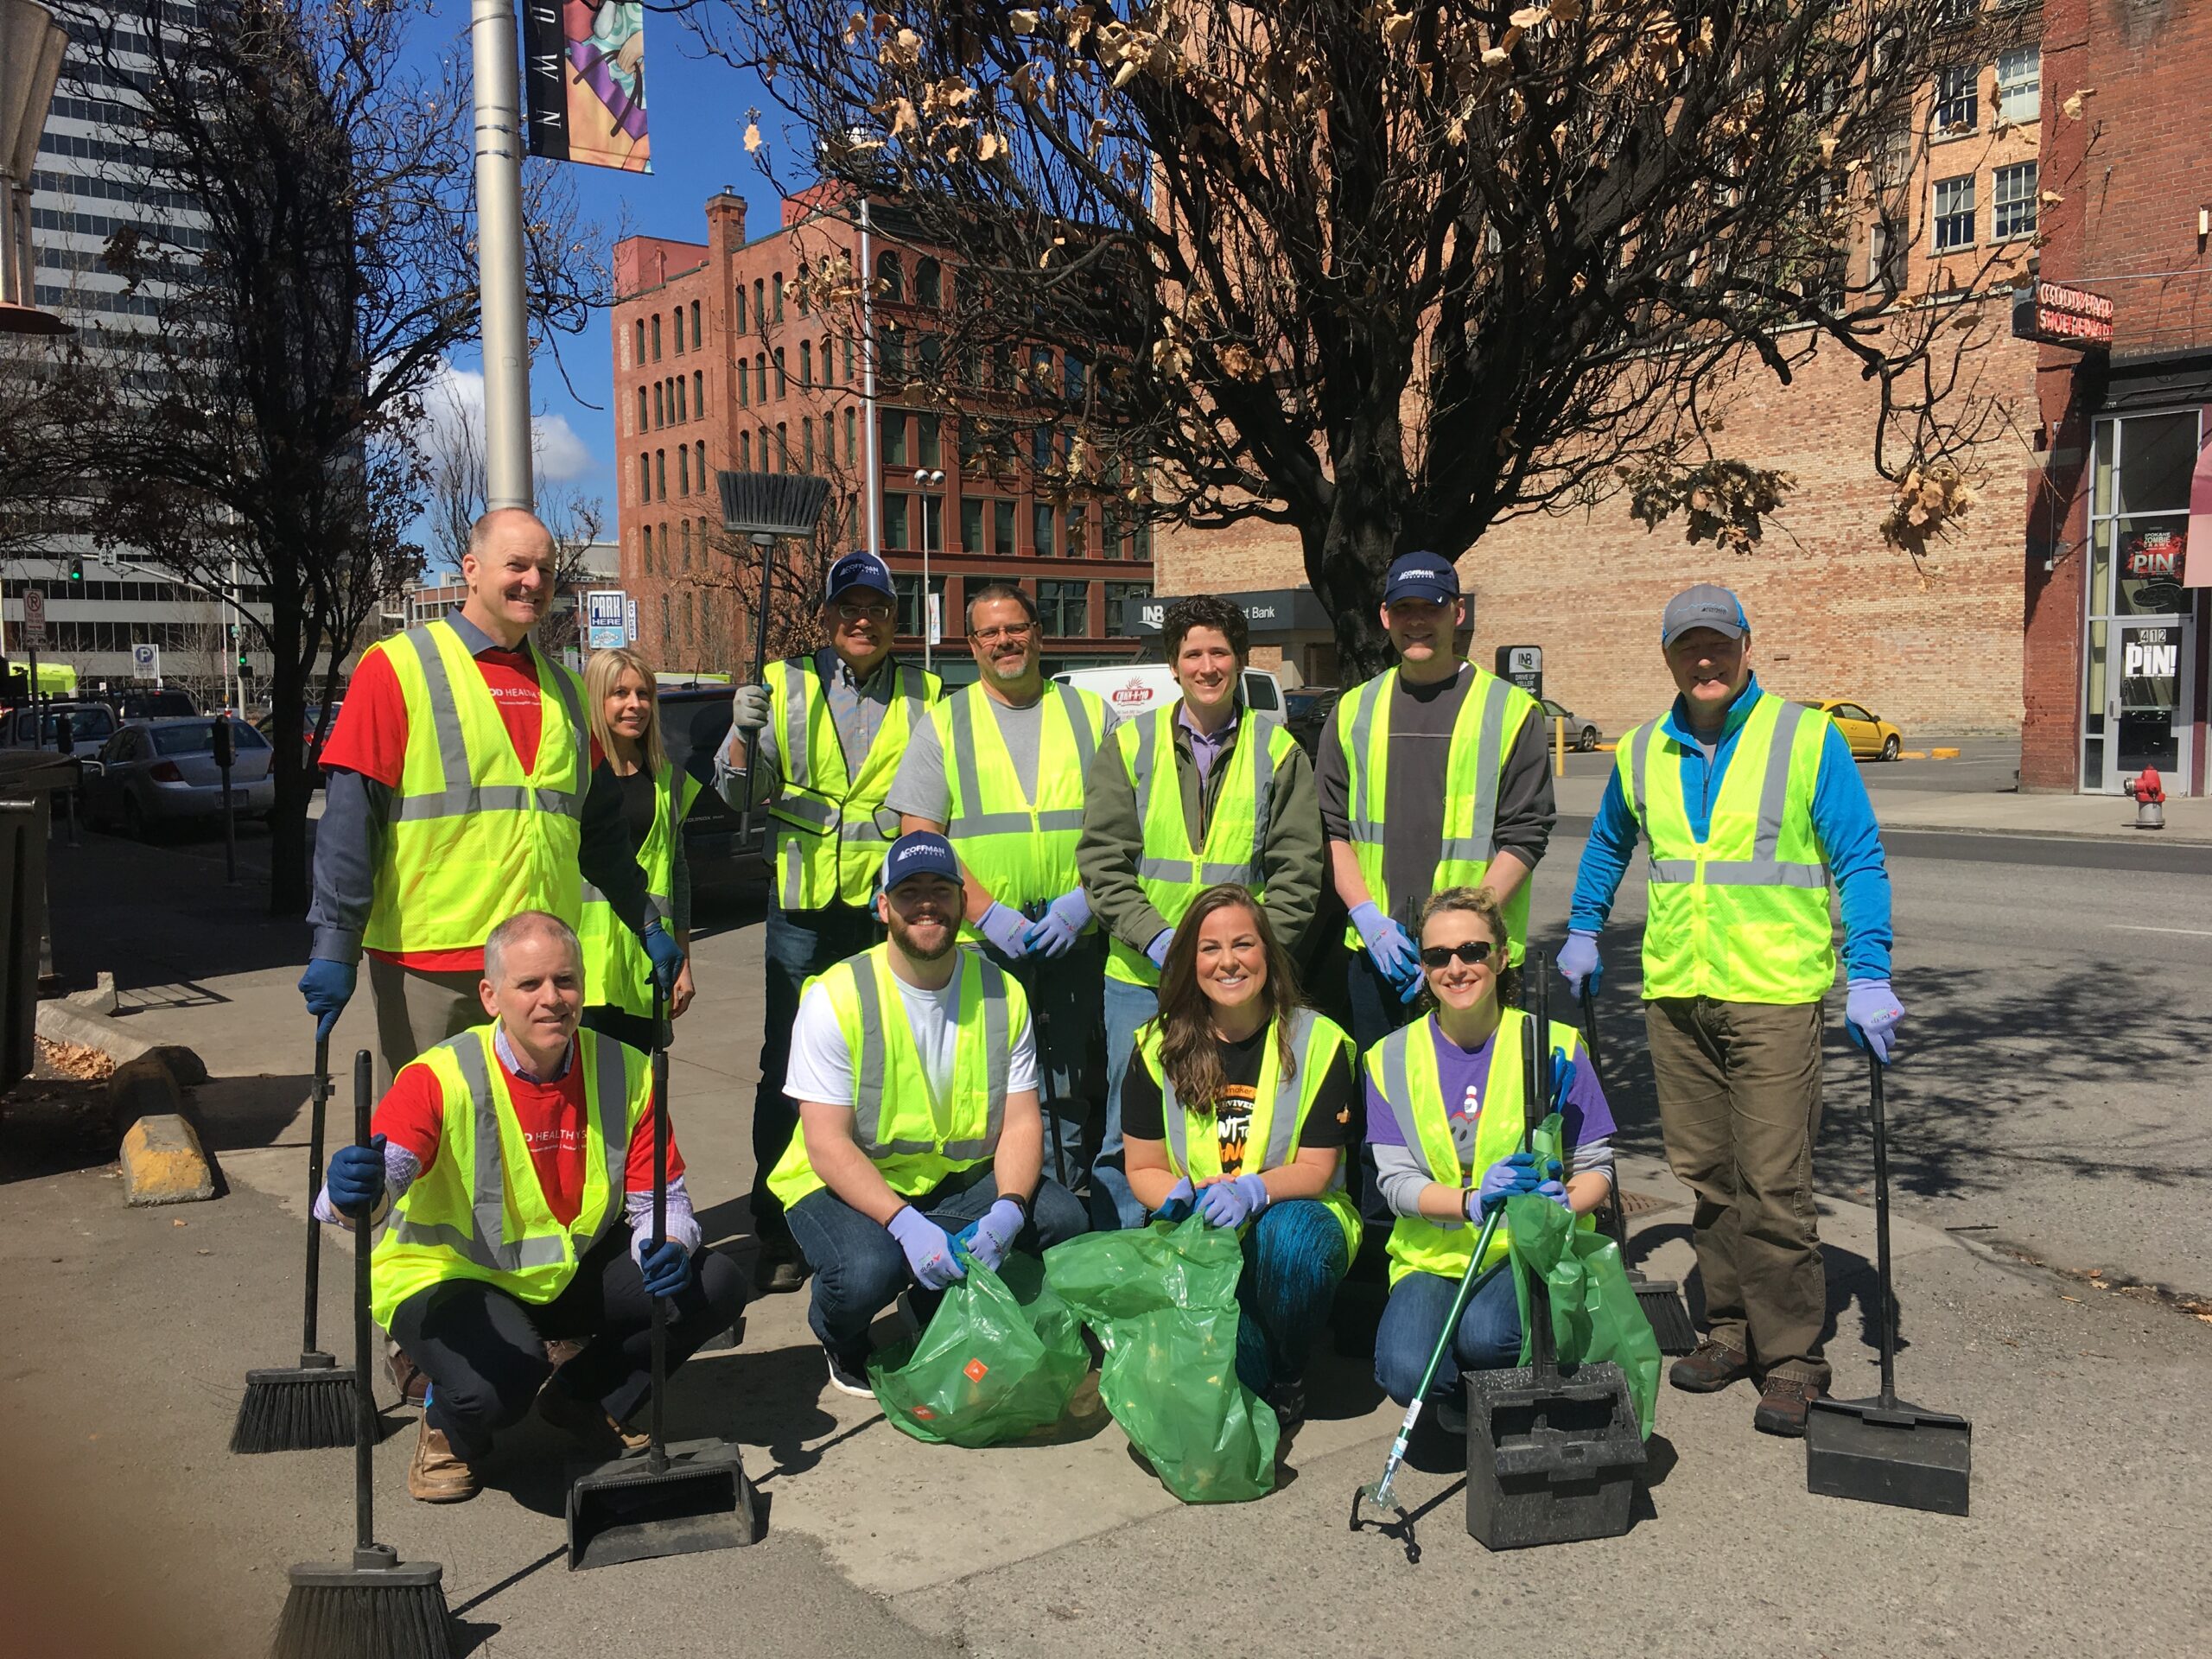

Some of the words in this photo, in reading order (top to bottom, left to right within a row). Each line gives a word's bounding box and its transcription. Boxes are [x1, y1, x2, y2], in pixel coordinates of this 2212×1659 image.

[2133, 553, 2174, 573] PIN
[592, 596, 620, 618] PARK
[1253, 607, 1274, 619] Bank
[1142, 606, 1164, 621] INB
[2141, 630, 2166, 642] 412
[1518, 653, 1532, 664] INB
[905, 844, 945, 855] COFFMAN
[535, 1128, 574, 1141] HEALTH
